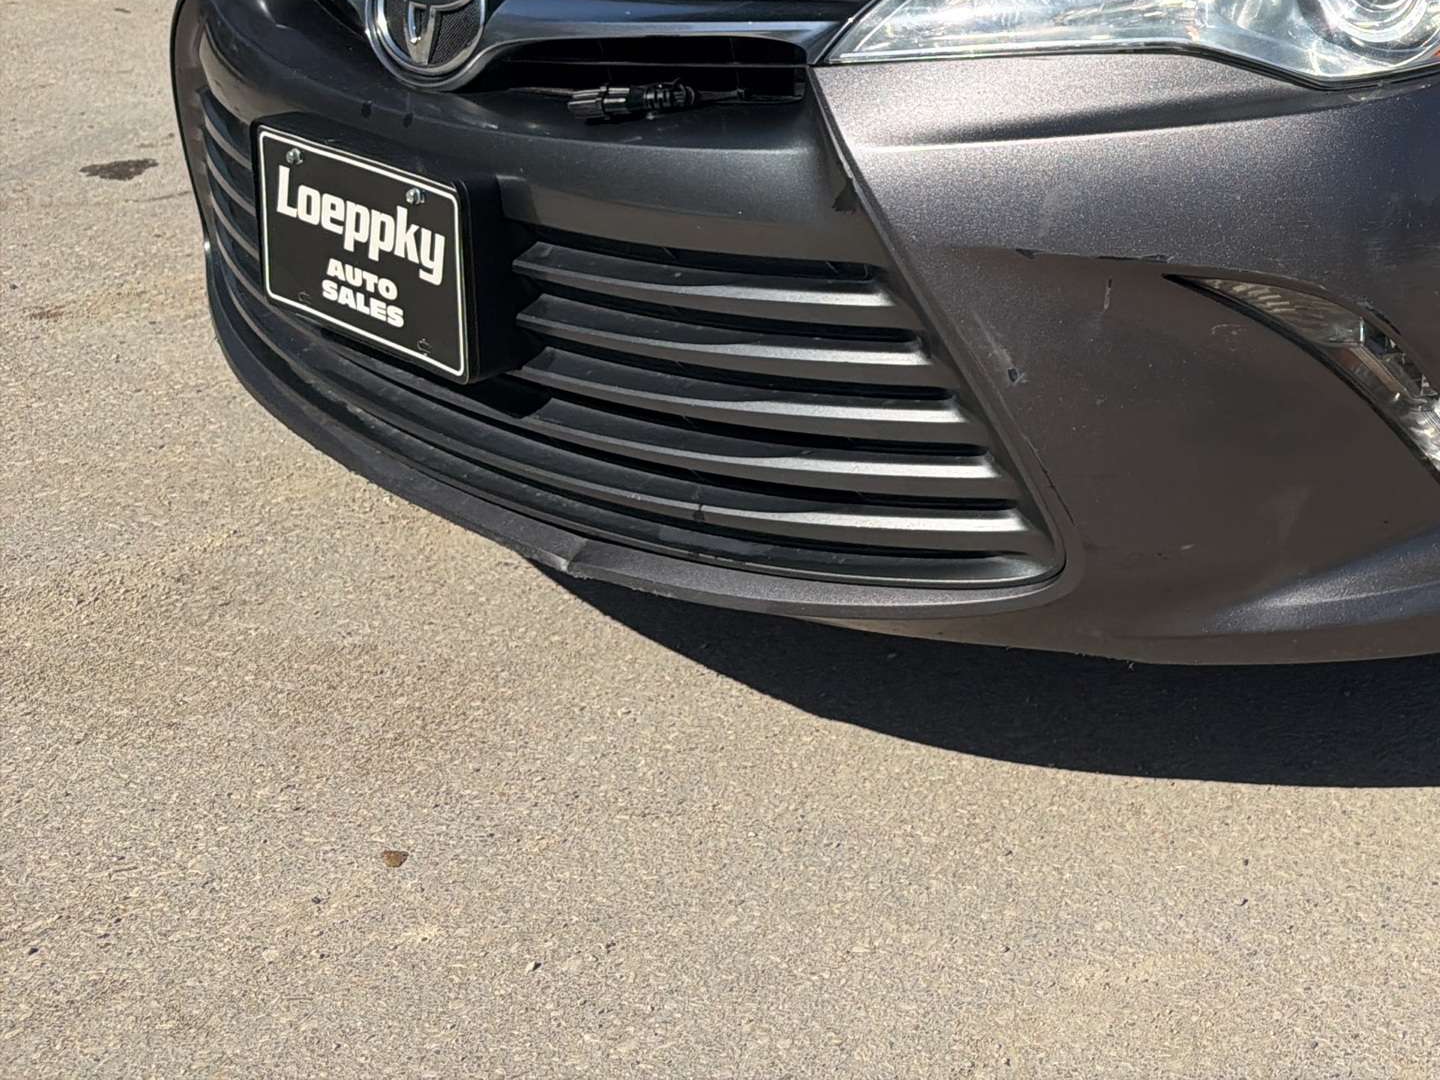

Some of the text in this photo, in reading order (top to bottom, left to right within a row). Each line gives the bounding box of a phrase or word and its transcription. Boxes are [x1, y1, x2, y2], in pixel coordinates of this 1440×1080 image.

[276, 164, 446, 286] Loeppky
[321, 279, 405, 329] SALES
[326, 257, 398, 301] AUTO
